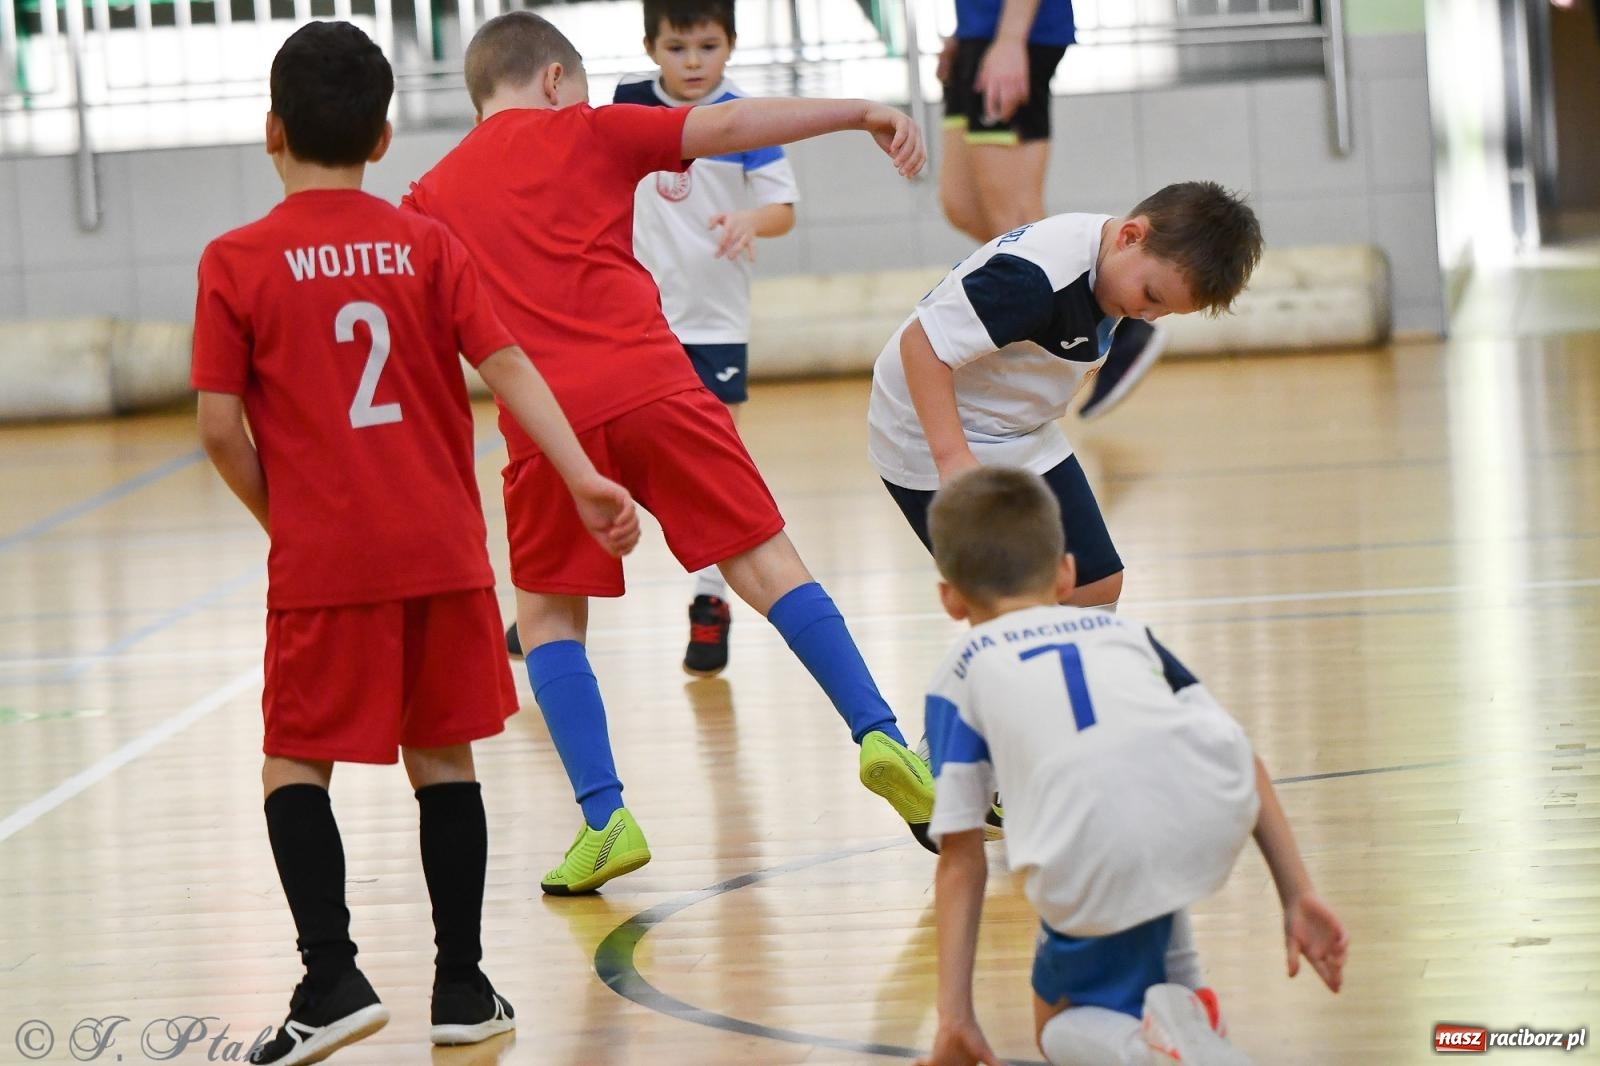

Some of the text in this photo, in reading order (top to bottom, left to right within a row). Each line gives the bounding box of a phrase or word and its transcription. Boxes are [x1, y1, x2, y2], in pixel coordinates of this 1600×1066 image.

[284, 241, 415, 282] WOJTEK
[335, 300, 403, 429] 2
[953, 614, 1124, 680] UNIA RACIBOR
[1018, 642, 1096, 732] 7
